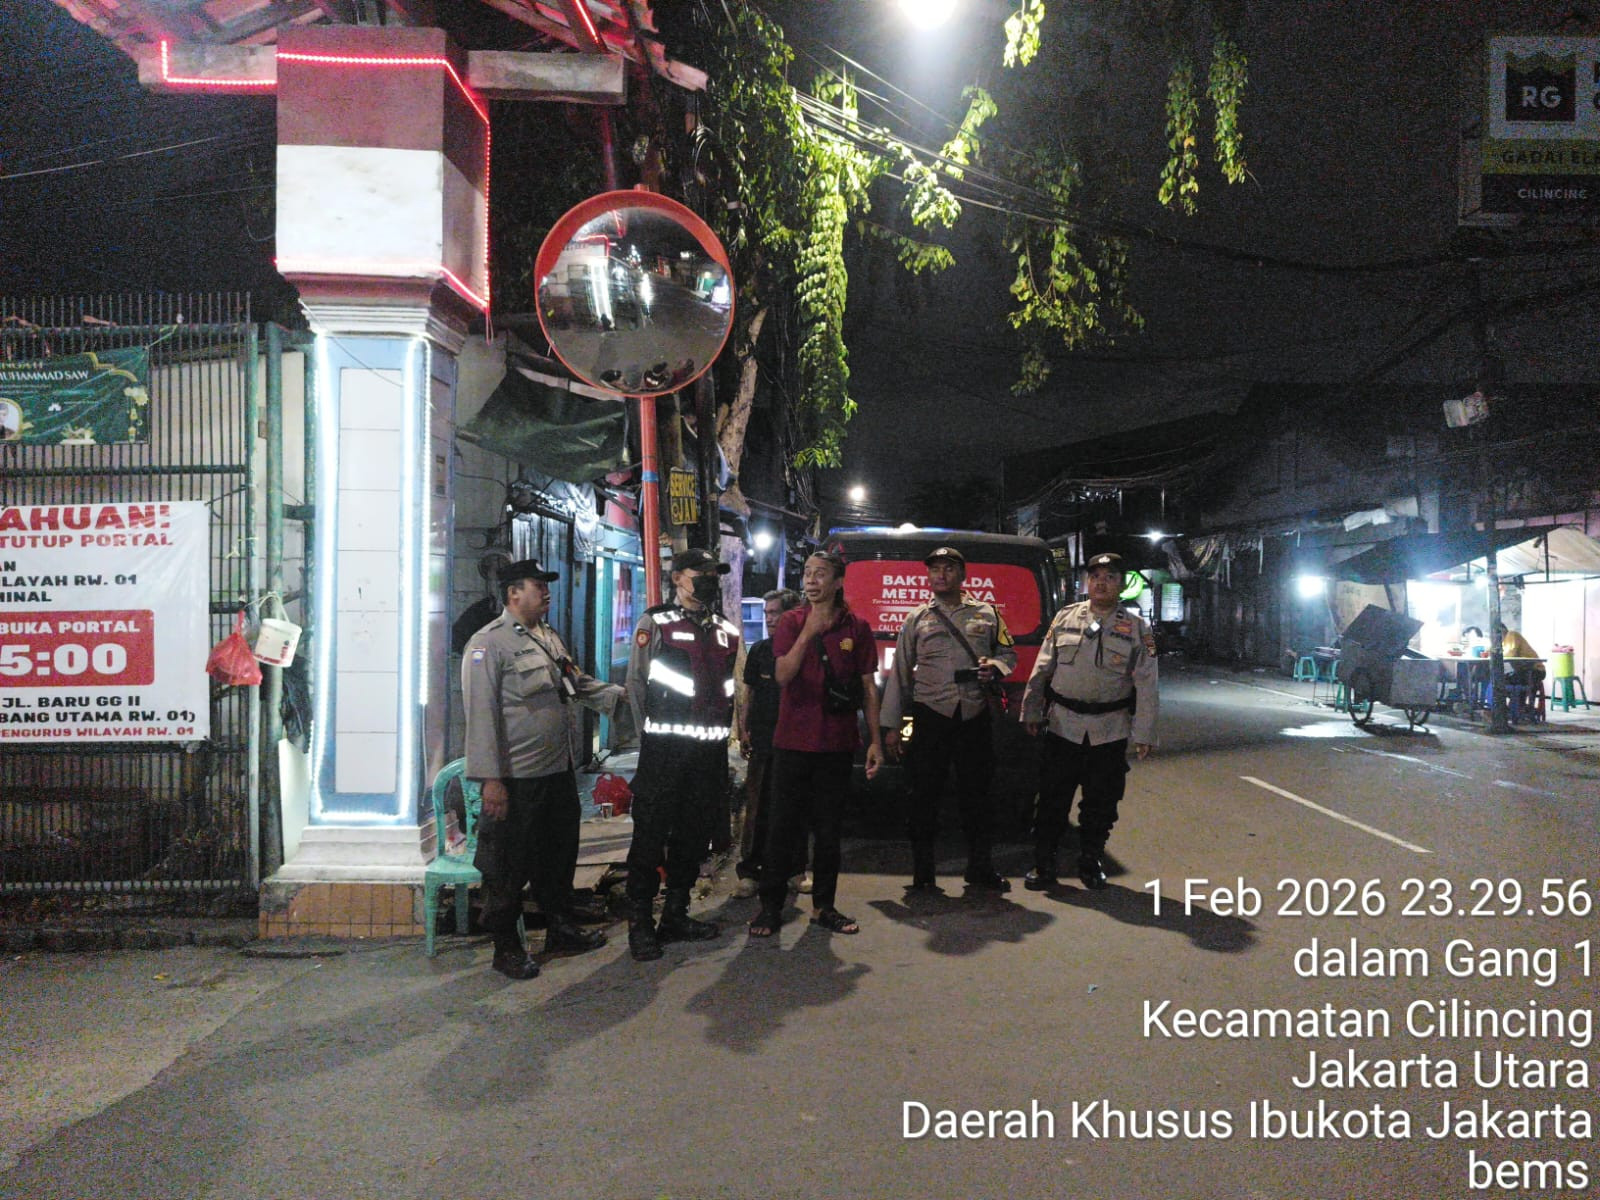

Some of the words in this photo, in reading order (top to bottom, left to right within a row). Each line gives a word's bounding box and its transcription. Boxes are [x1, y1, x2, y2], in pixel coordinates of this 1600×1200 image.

[1522, 86, 1562, 109] RG
[64, 370, 89, 380] SAW
[0, 534, 74, 549] TUTUP
[81, 533, 174, 547] PORTAL
[74, 575, 108, 586] RW.
[115, 574, 137, 585] 01
[883, 575, 930, 586] BAKT
[882, 588, 932, 600] METR
[0, 622, 53, 634] BUKA
[59, 620, 141, 633] PORTAL
[0, 643, 128, 676] 5:00
[2, 698, 32, 708] JL.
[38, 697, 91, 708] BARU
[96, 696, 123, 706] GG
[128, 696, 141, 706] II
[56, 712, 123, 722] UTAMA
[129, 711, 160, 721] RW.
[167, 710, 196, 723] 01)
[76, 727, 142, 737] WILAYAH
[147, 727, 172, 736] RW.
[176, 727, 194, 736] 01
